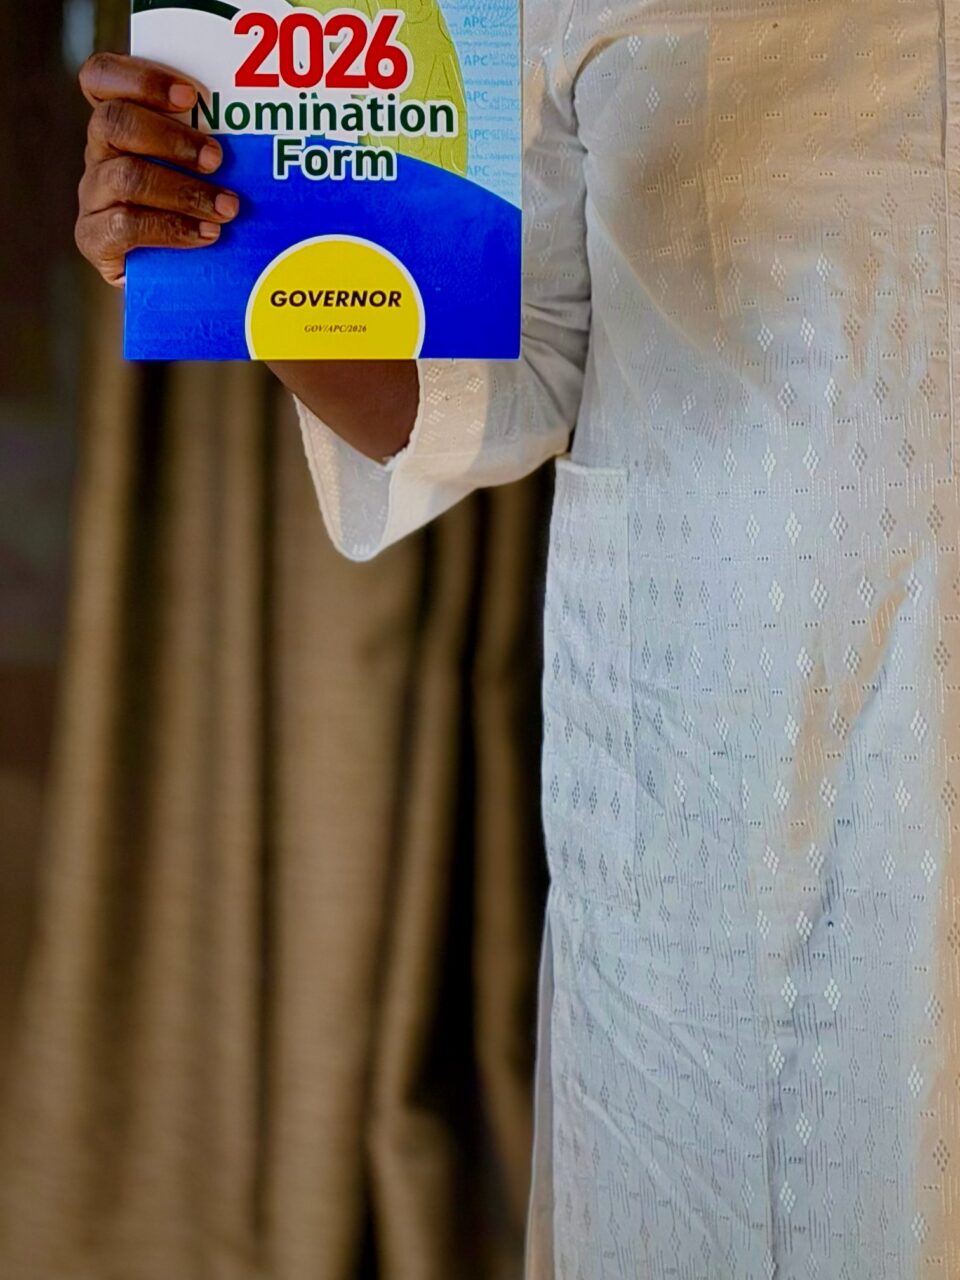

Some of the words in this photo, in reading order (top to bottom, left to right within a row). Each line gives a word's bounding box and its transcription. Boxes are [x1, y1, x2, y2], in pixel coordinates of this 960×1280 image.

[234, 12, 408, 90] 2026
[191, 91, 454, 133] Nomination
[277, 138, 394, 177] Form
[270, 290, 402, 308] GOVERNOR
[304, 324, 367, 333] GOV/APC/2026
